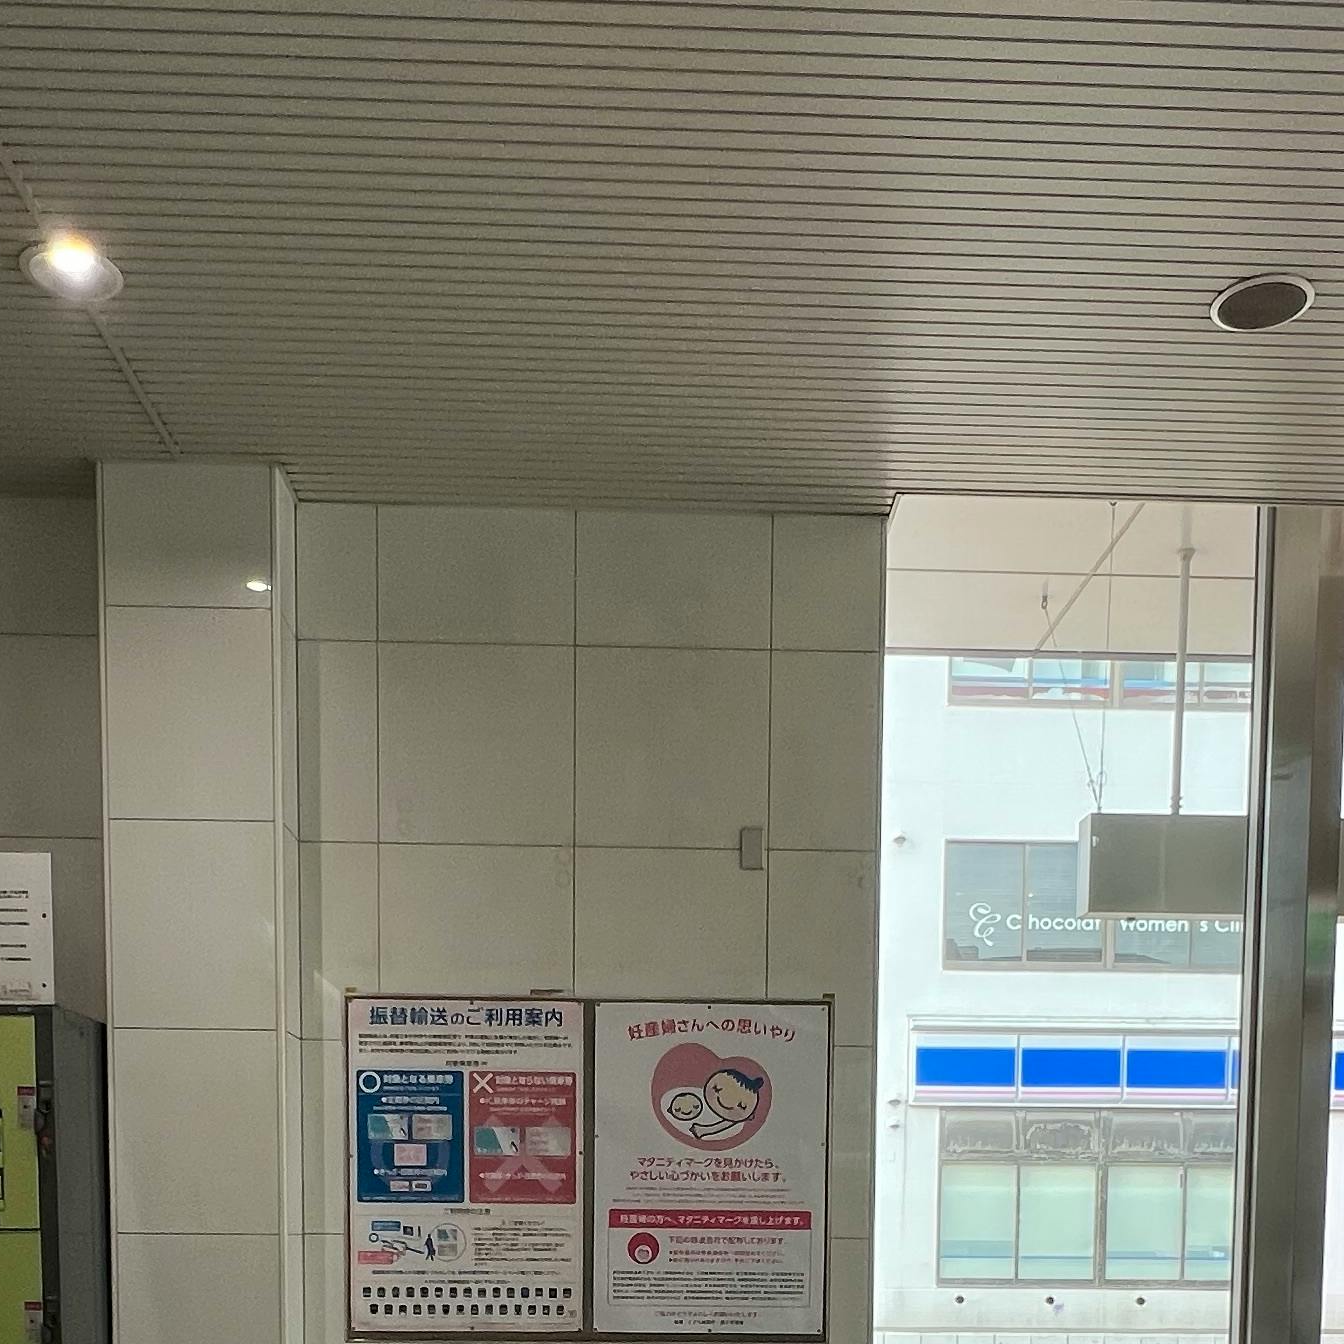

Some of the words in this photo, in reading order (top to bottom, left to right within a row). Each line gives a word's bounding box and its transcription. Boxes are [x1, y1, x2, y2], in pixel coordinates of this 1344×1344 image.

[369, 1006, 563, 1028] 振替輸送のご利用案内
[627, 1017, 796, 1042] 妊産婦さんへの思いやり
